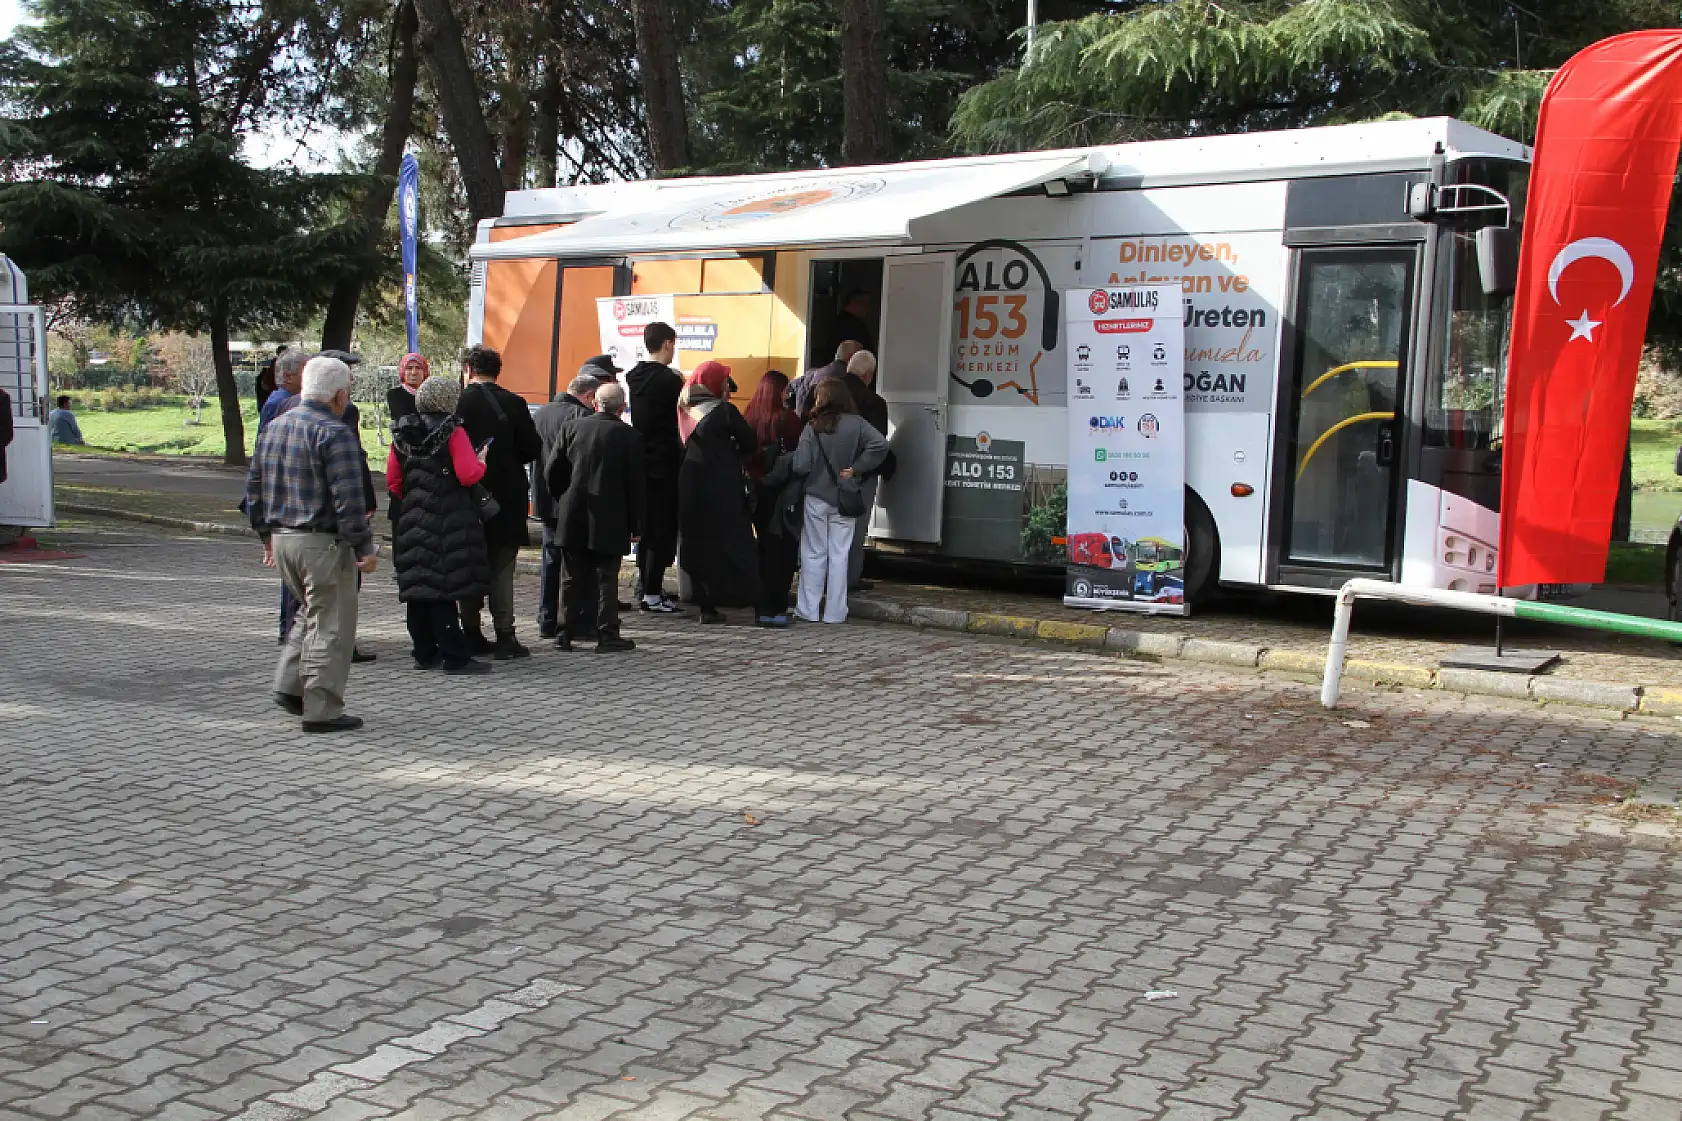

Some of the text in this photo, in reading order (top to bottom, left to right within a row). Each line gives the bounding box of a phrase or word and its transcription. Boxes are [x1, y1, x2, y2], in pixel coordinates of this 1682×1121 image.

[1119, 240, 1238, 267] Dinleyen,
[956, 260, 1028, 291] ALO
[1218, 275, 1249, 293] ve
[955, 294, 1027, 339] 153
[957, 342, 1019, 360] ÇÖZÜM
[956, 362, 1019, 372] MERKEZİ
[951, 461, 1014, 479] ALO 153
